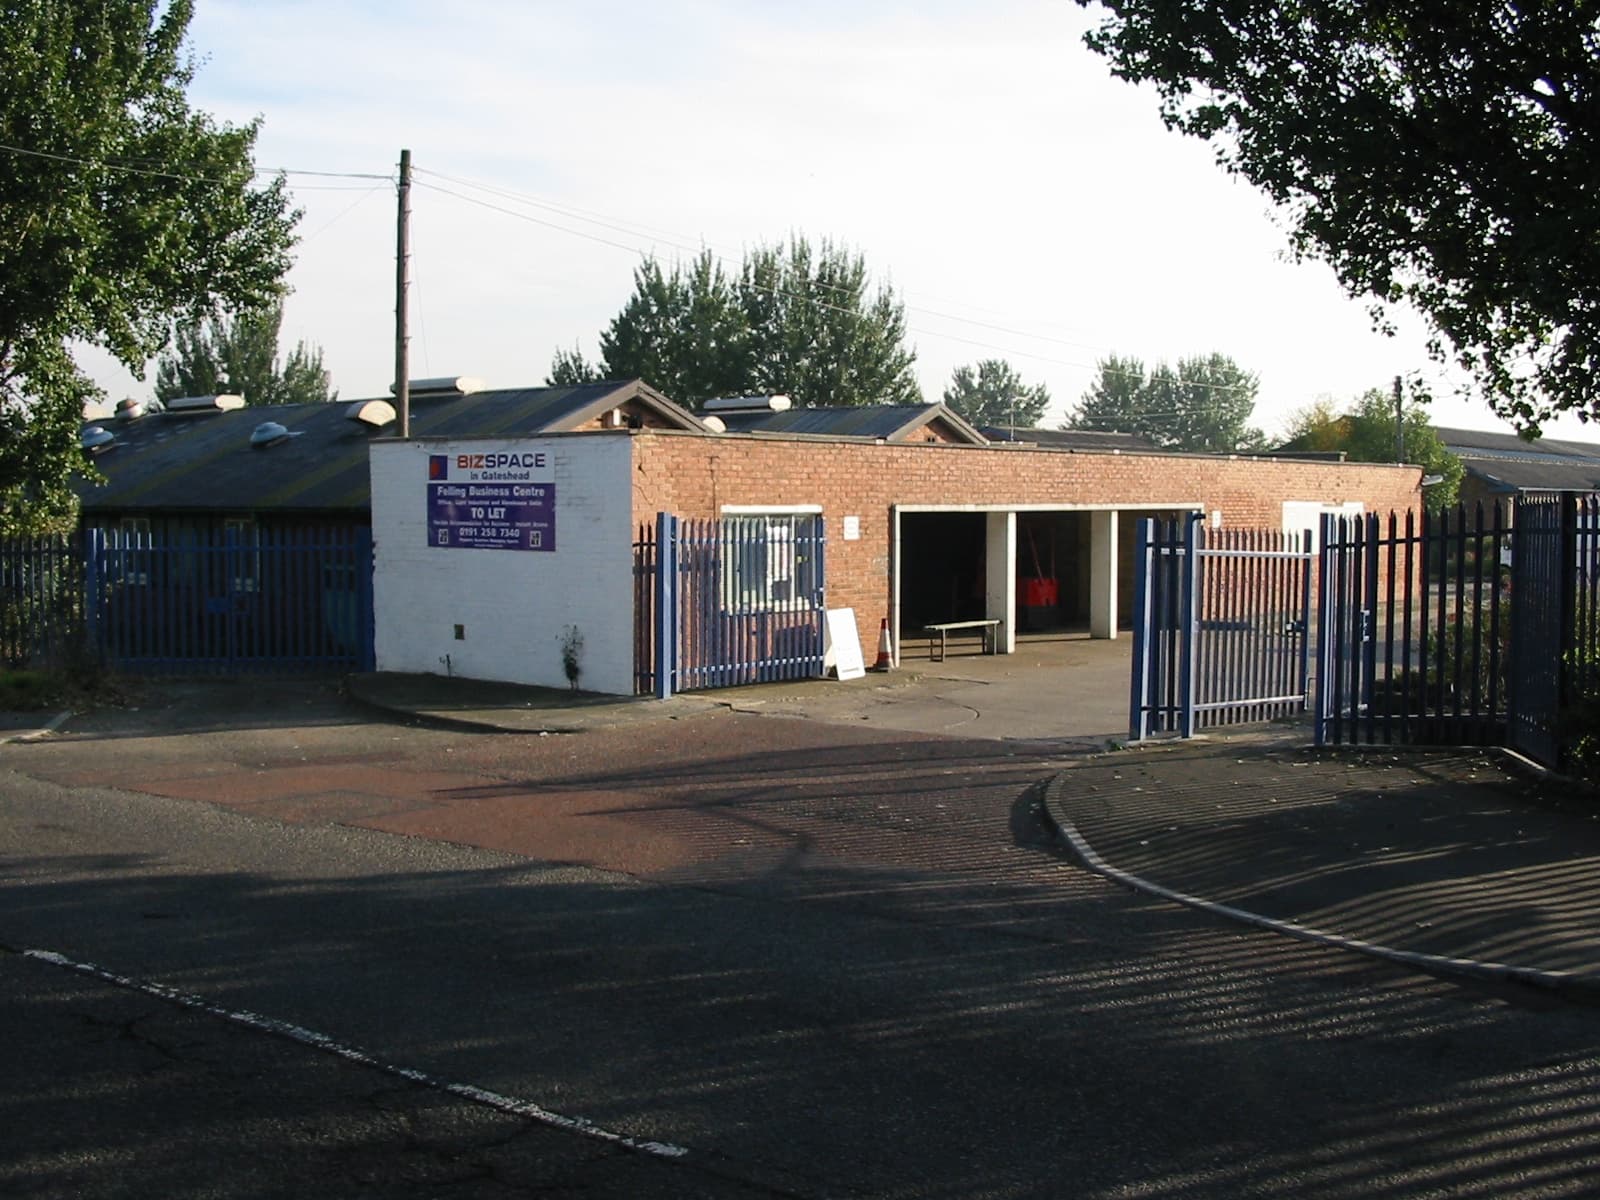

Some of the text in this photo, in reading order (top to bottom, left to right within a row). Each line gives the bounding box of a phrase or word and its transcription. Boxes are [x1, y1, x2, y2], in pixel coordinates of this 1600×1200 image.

[457, 454, 546, 468] BIZSPACE
[481, 471, 530, 480] Gateshead
[469, 486, 509, 497] Business
[513, 486, 545, 497] Centre
[471, 507, 506, 519] TO LET
